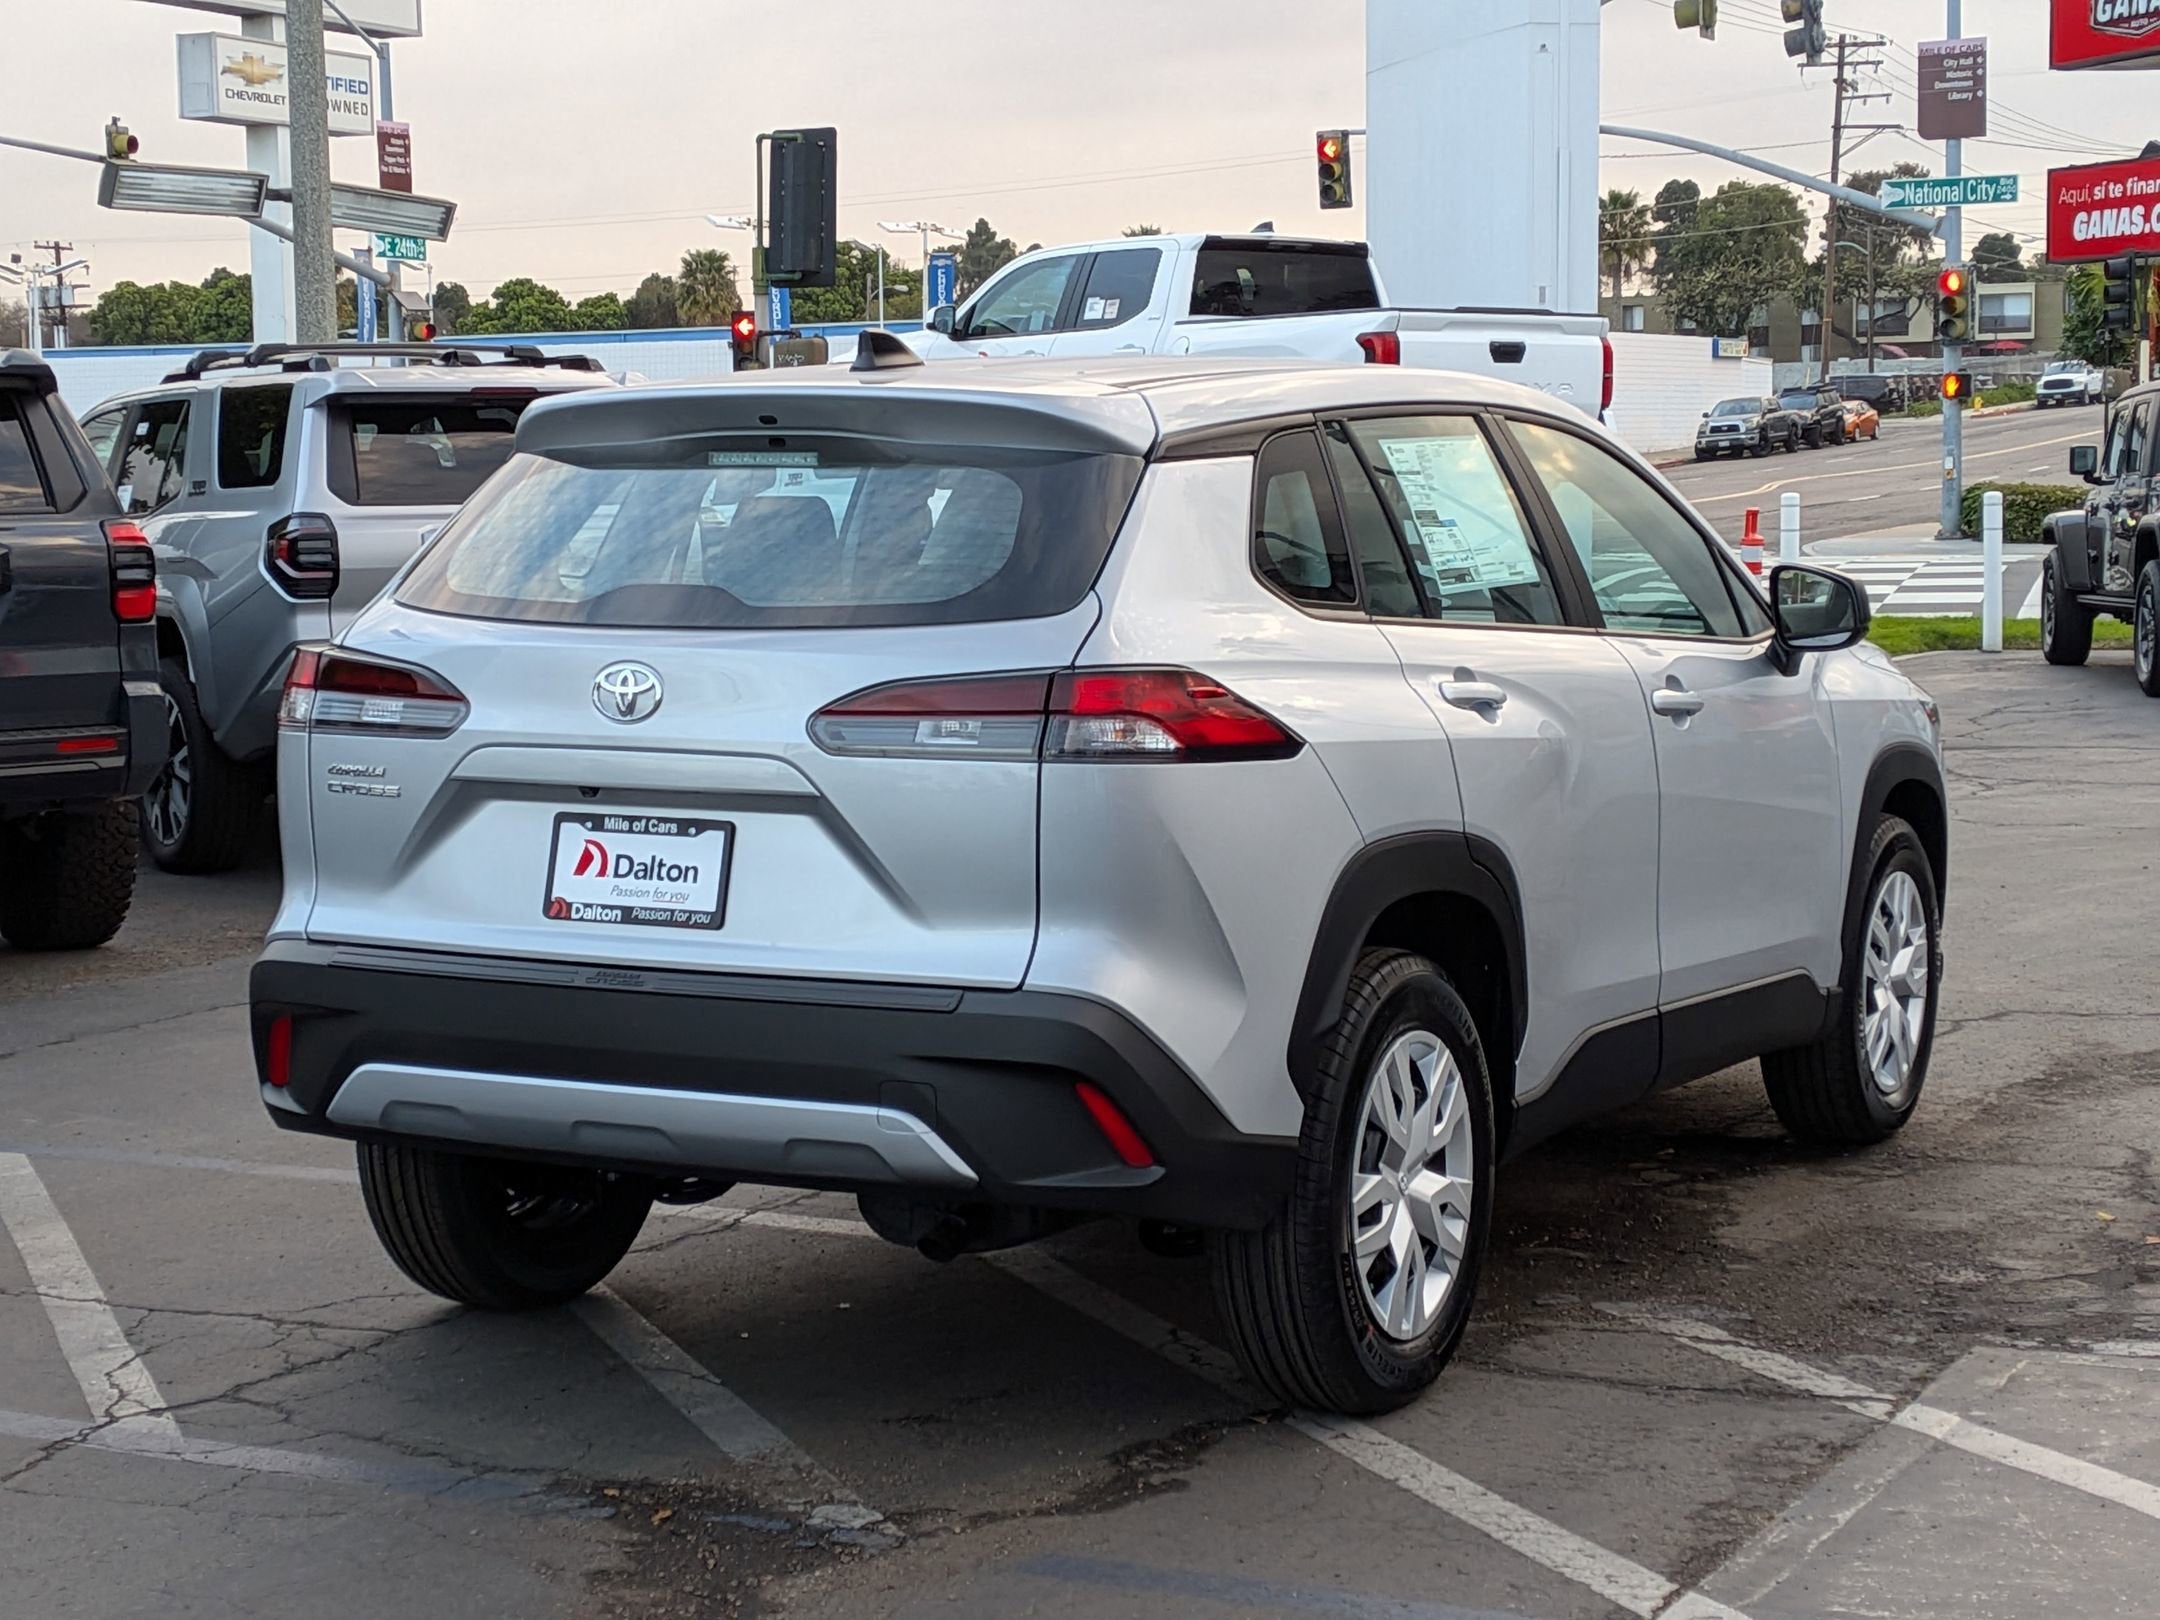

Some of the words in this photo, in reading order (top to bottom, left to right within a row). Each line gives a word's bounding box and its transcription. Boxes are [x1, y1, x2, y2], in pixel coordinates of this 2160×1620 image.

[225, 88, 287, 106] CHEVROLET
[1904, 180, 1964, 205] National
[1967, 179, 1997, 202] City
[2093, 180, 2107, 201] sí
[2108, 181, 2124, 198] te
[385, 237, 393, 256] E
[395, 238, 417, 258] 24th
[327, 780, 401, 798] CROSS
[604, 816, 628, 831] Mile
[632, 818, 645, 832] of
[648, 819, 678, 834] Cars
[612, 853, 699, 884] Dalton
[610, 884, 651, 898] Passion
[652, 887, 671, 902] for
[670, 890, 690, 902] you
[571, 903, 622, 922] Dalton
[631, 907, 671, 921] Passion
[672, 910, 689, 923] for
[688, 913, 711, 925] you
